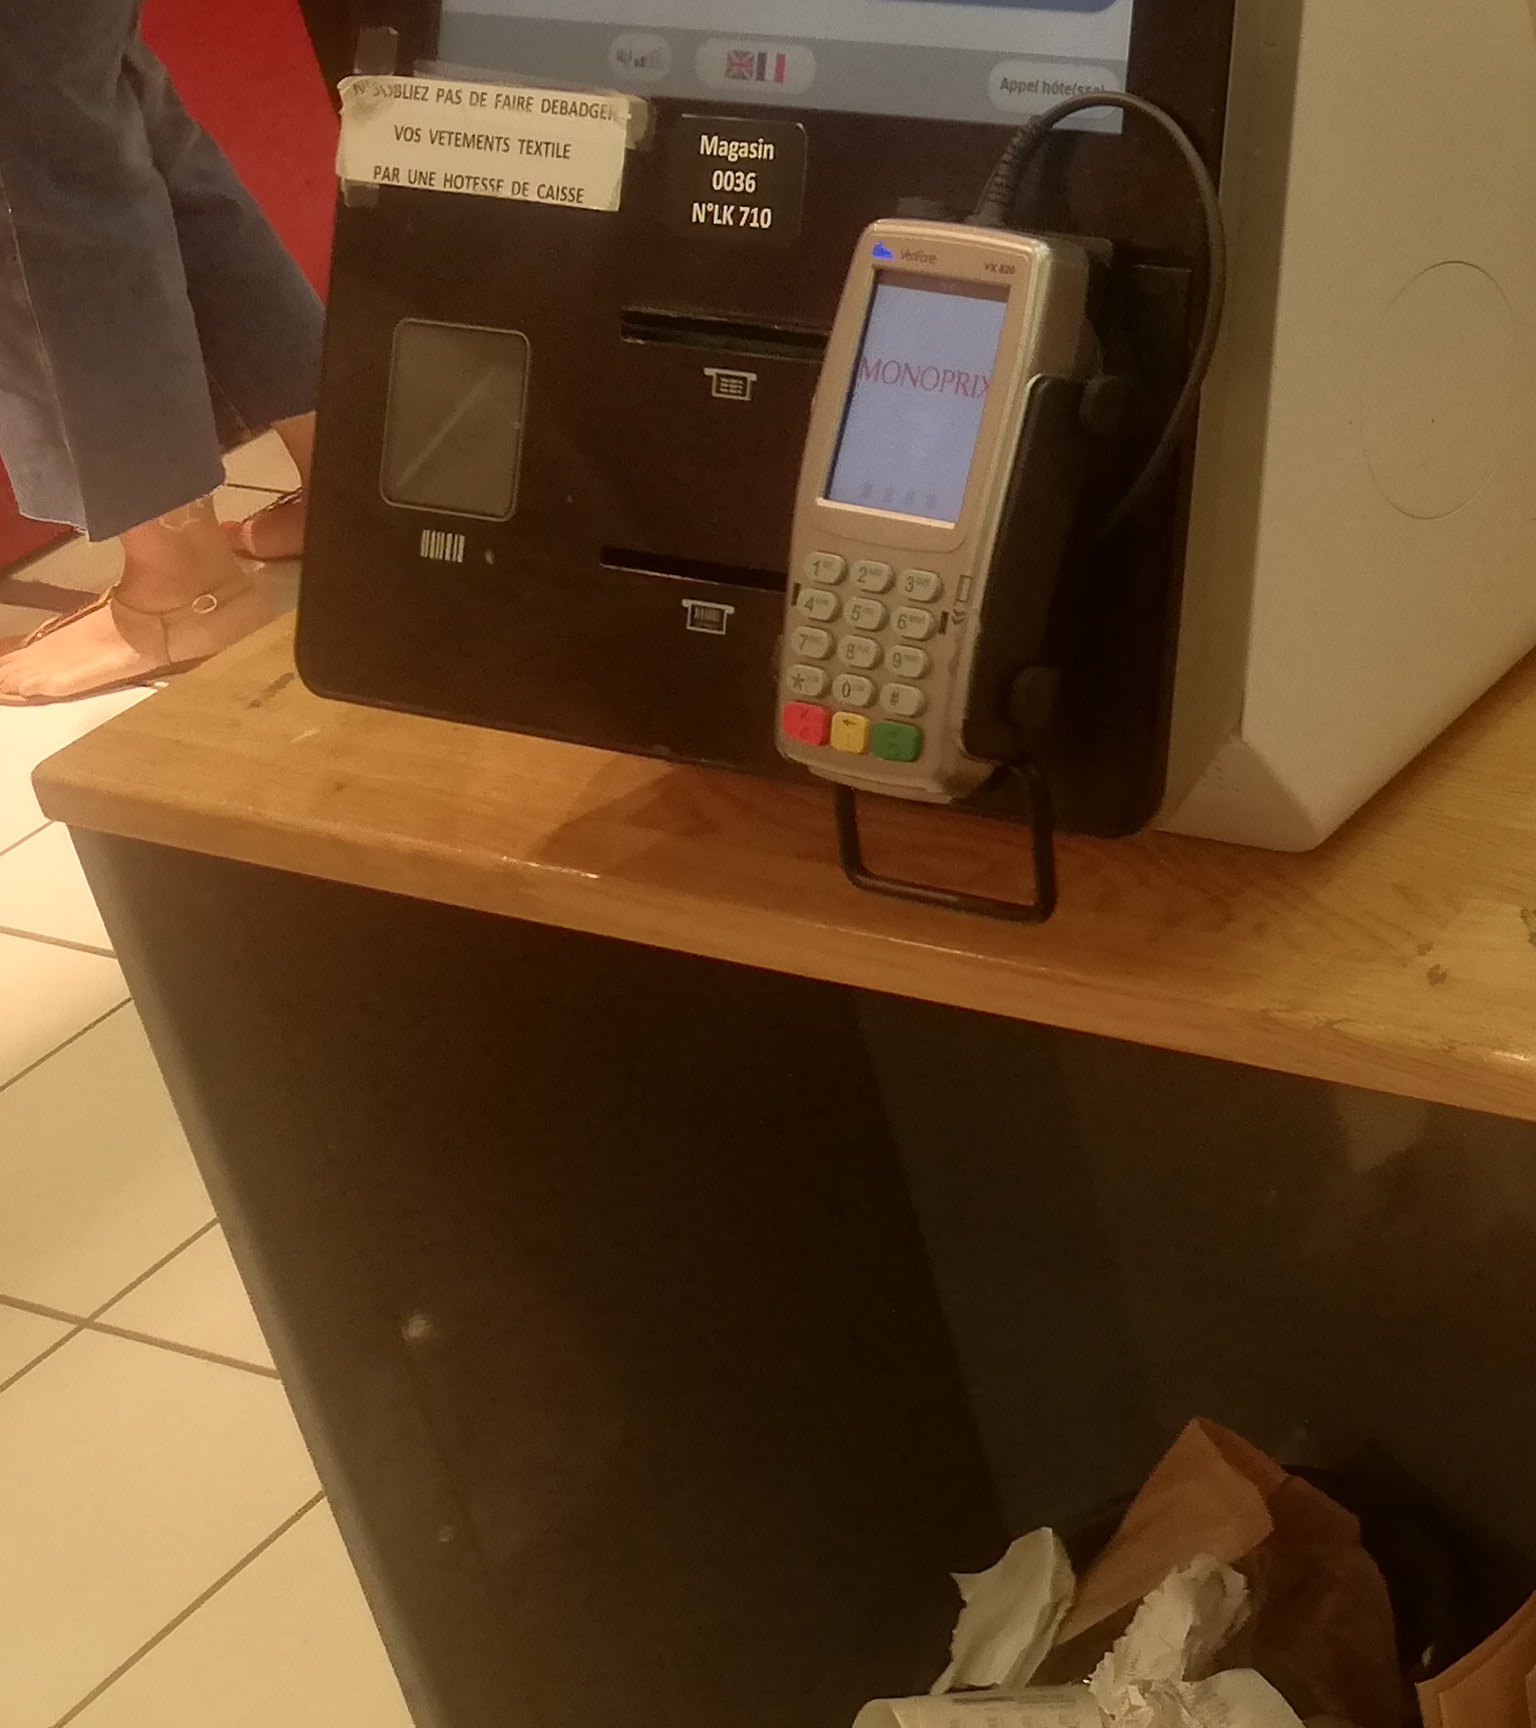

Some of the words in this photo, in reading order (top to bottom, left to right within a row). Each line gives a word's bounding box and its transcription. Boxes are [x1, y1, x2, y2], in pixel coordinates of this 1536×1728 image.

[699, 135, 775, 162] Magasin
[712, 169, 756, 195] 0036
[690, 201, 736, 228] N°LK
[739, 203, 773, 229] 710
